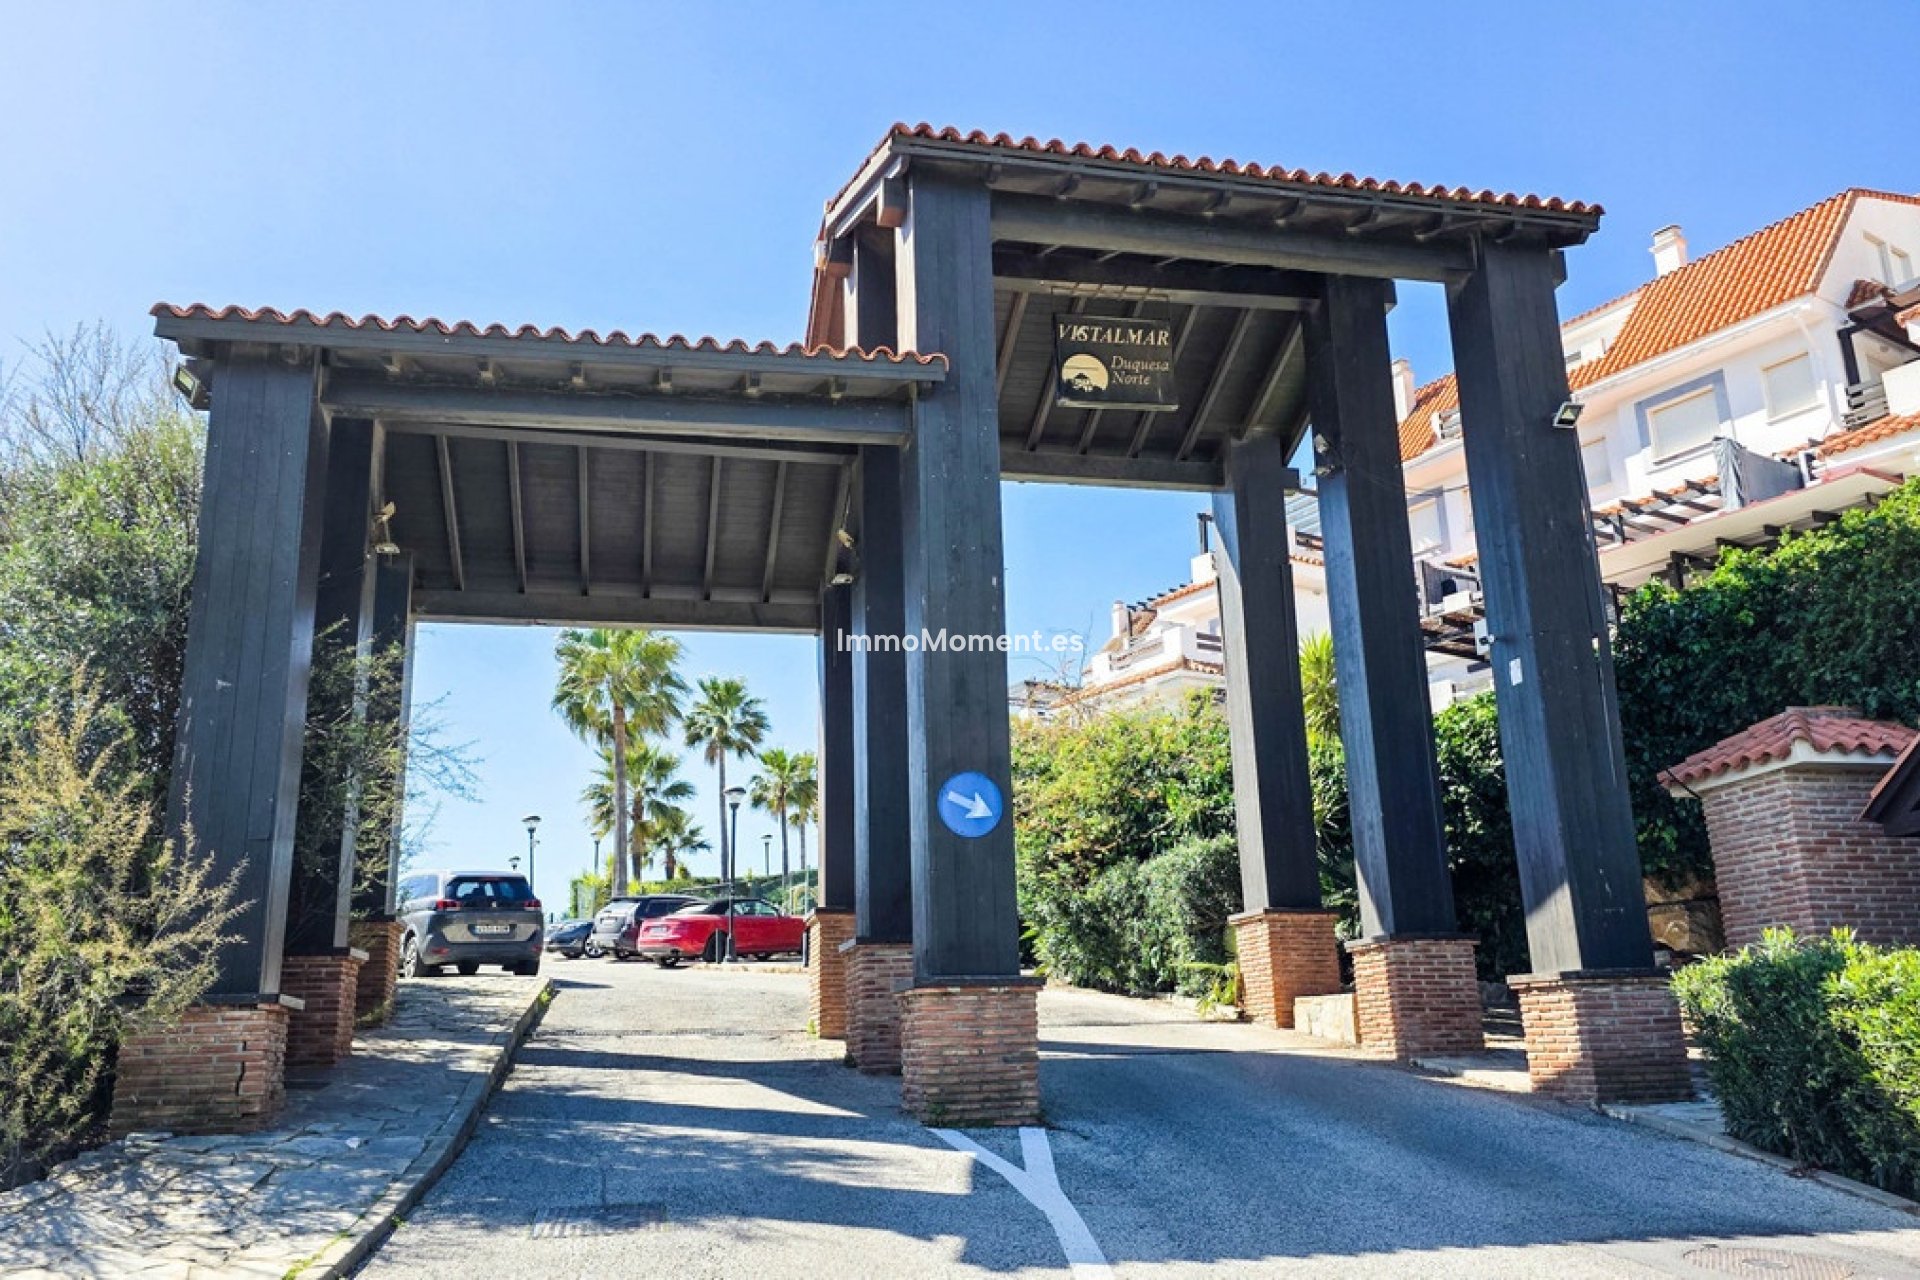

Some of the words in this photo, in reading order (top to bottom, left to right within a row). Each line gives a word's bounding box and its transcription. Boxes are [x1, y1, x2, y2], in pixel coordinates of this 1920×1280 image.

[1059, 323, 1169, 345] VISTALMAR
[1111, 355, 1169, 373] Duquesa
[1112, 371, 1151, 385] Norte
